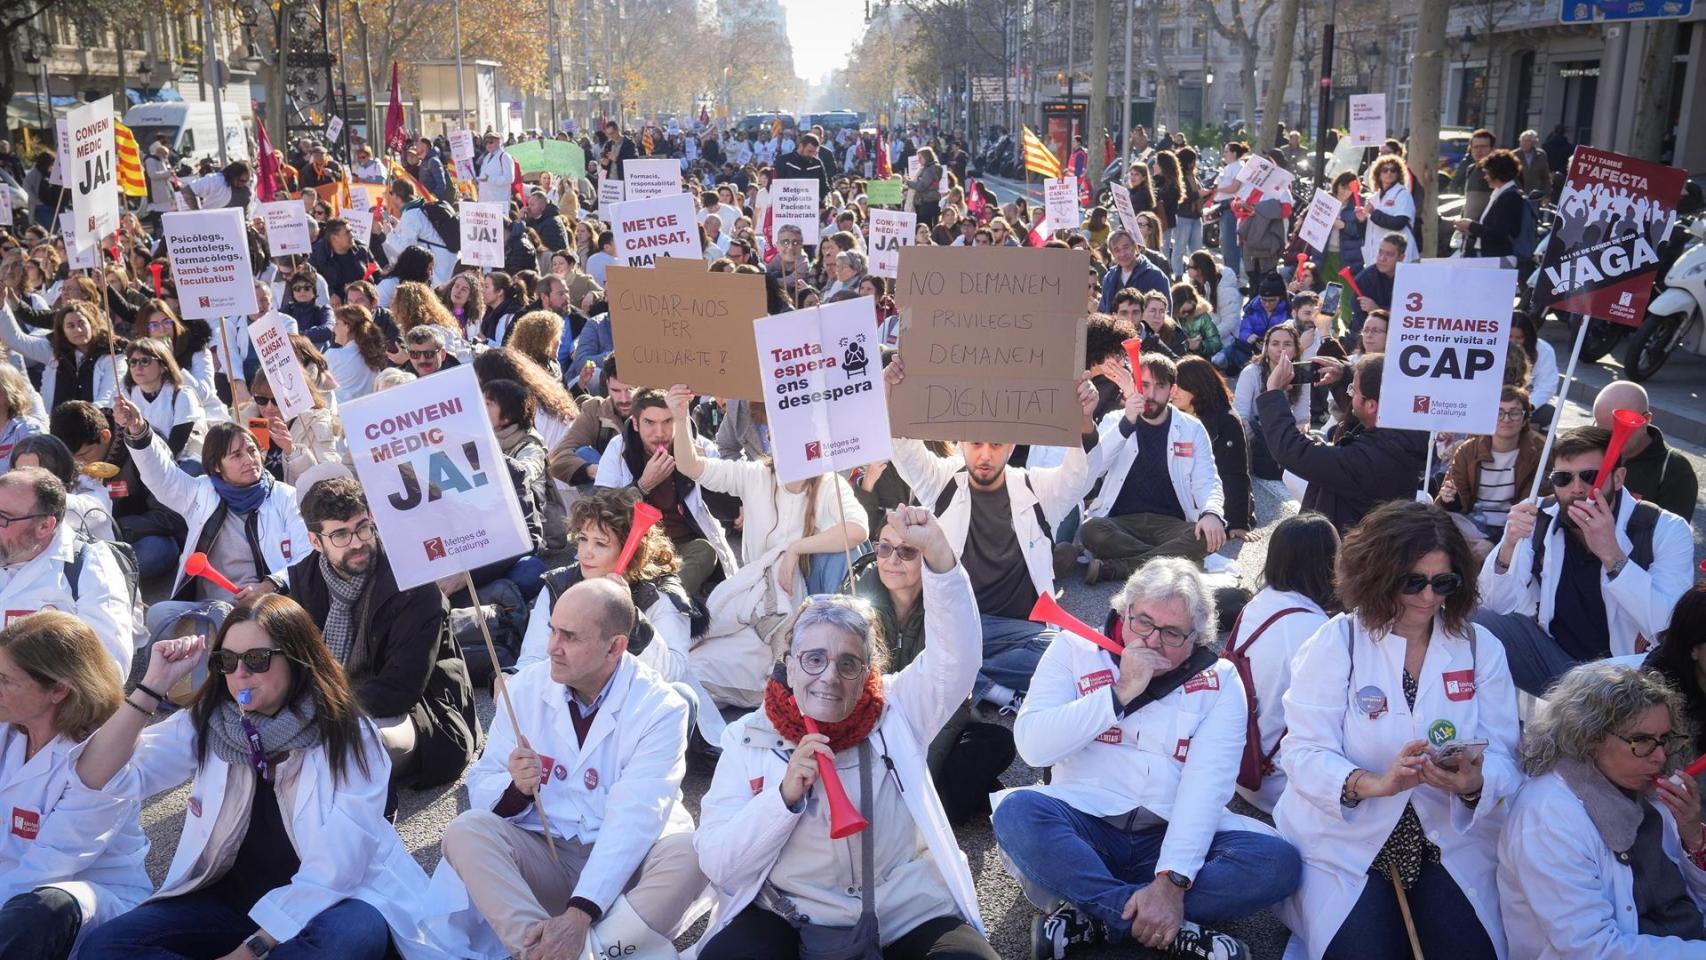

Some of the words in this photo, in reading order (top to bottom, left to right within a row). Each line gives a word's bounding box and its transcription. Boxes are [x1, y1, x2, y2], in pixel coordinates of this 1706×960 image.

[76, 117, 108, 141] CONVENI
[76, 138, 101, 158] MÈDIC
[79, 150, 111, 195] JA!
[1598, 158, 1622, 168] TAMBÉ
[1578, 162, 1648, 190] T'AFECTA
[622, 214, 678, 233] METGE
[170, 234, 224, 243] Psicòlegs,
[467, 226, 497, 243] JA!
[626, 231, 690, 250] CANSAT,
[173, 244, 234, 254] odontòlegs,
[1592, 242, 1611, 251] GENER
[175, 254, 243, 264] farmacòlegs,
[1544, 237, 1659, 294] VAGA
[177, 266, 209, 275] també
[180, 275, 235, 286] facultatius
[910, 272, 945, 296] NO
[960, 272, 1060, 296] DEMANEM
[619, 289, 728, 318] CUIDAR-NOS
[1406, 292, 1423, 312] 3
[662, 319, 692, 339] PER
[933, 309, 1033, 330] PRIVILEGIS
[1402, 317, 1499, 333] SETMANES
[256, 327, 278, 346] METGE
[1401, 334, 1420, 342] per
[1424, 335, 1451, 343] tenir
[1454, 335, 1483, 345] visita
[1487, 337, 1496, 345] al
[771, 342, 822, 363] Tanta
[929, 343, 1046, 368] DEMANEM
[774, 355, 836, 379] espera
[1399, 345, 1494, 380] CAP
[777, 378, 809, 394] ens
[779, 380, 872, 410] desespera
[1430, 408, 1466, 417] Catalunya
[1431, 400, 1457, 409] Metges
[365, 397, 463, 440] CONVENI
[370, 427, 444, 463] MÈDIC
[823, 440, 850, 451] Metges
[824, 444, 860, 457] Catalunya
[388, 440, 489, 510] JA!
[444, 533, 475, 547] Metges
[476, 528, 486, 537] de
[447, 538, 490, 555] Catalunya
